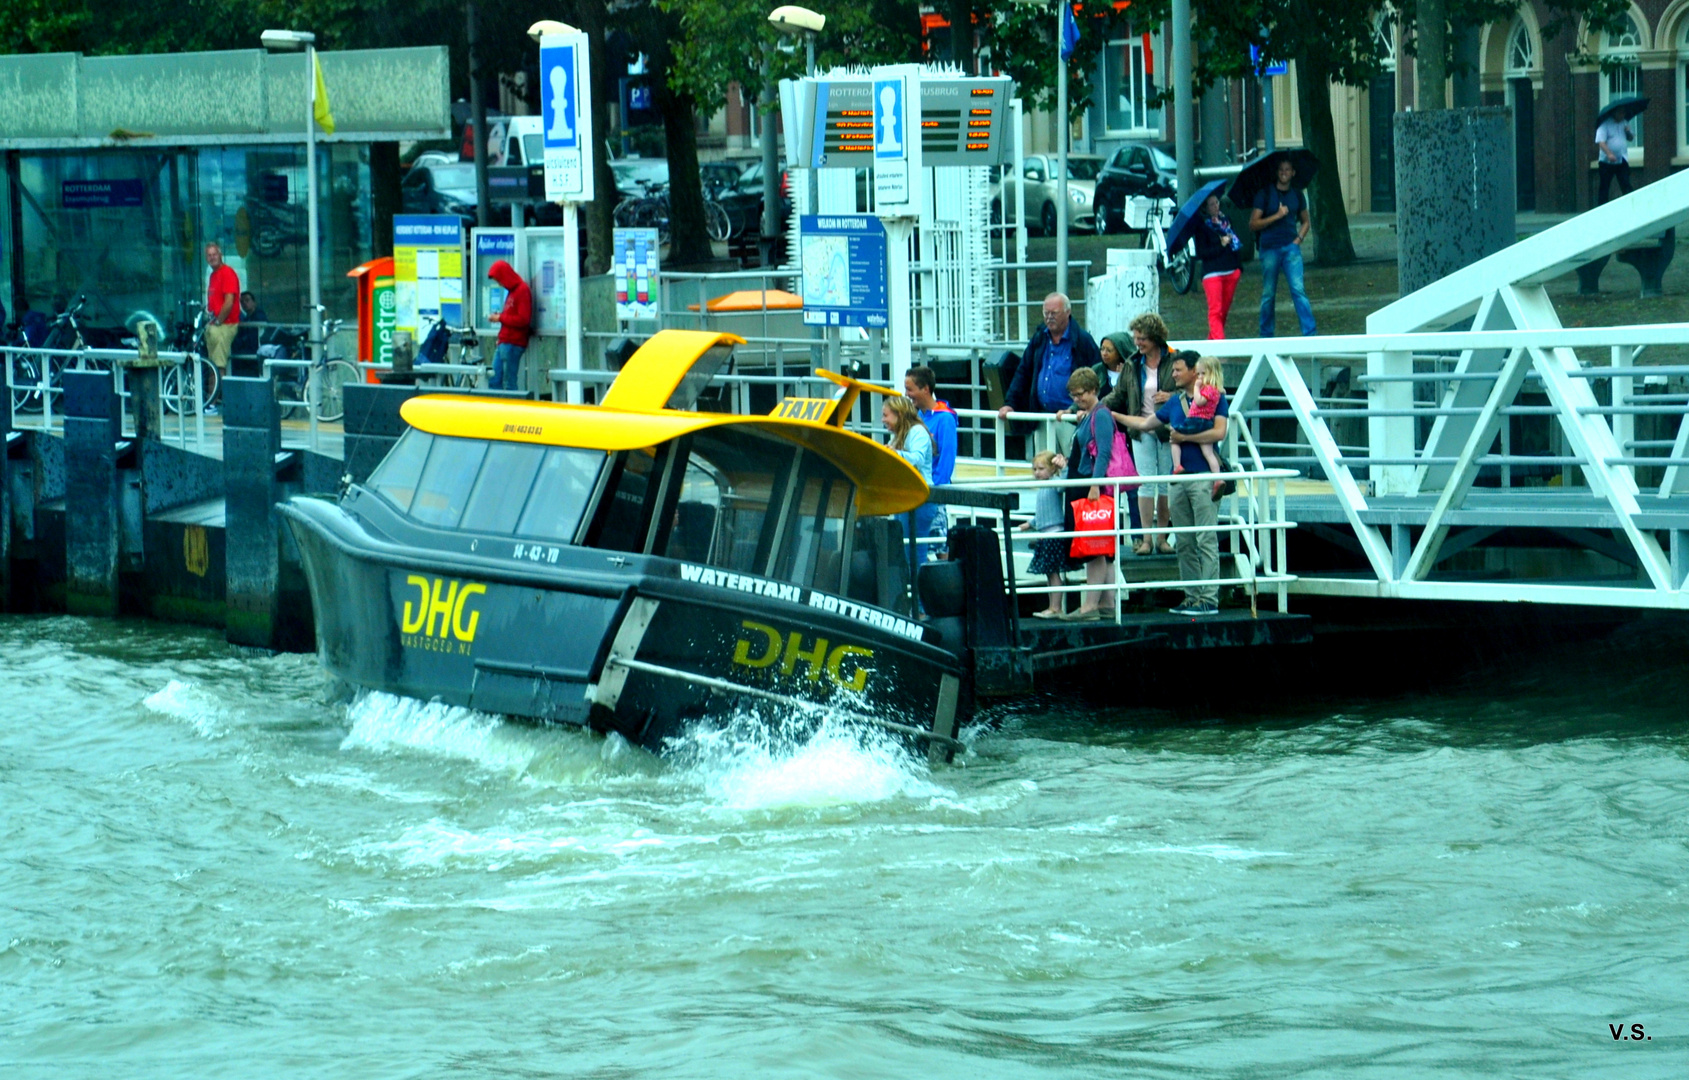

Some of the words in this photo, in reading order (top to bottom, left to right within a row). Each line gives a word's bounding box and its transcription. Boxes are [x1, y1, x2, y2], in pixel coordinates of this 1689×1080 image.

[65, 184, 111, 192] ROTTERDAM
[842, 218, 867, 229] ROTTERDAM
[1128, 281, 1146, 298] 18
[778, 399, 827, 421] TAXI
[402, 574, 487, 642] DHG
[680, 563, 801, 603] WATERTAXI
[809, 590, 924, 641] ROTTERDAM
[732, 619, 874, 692] DHG
